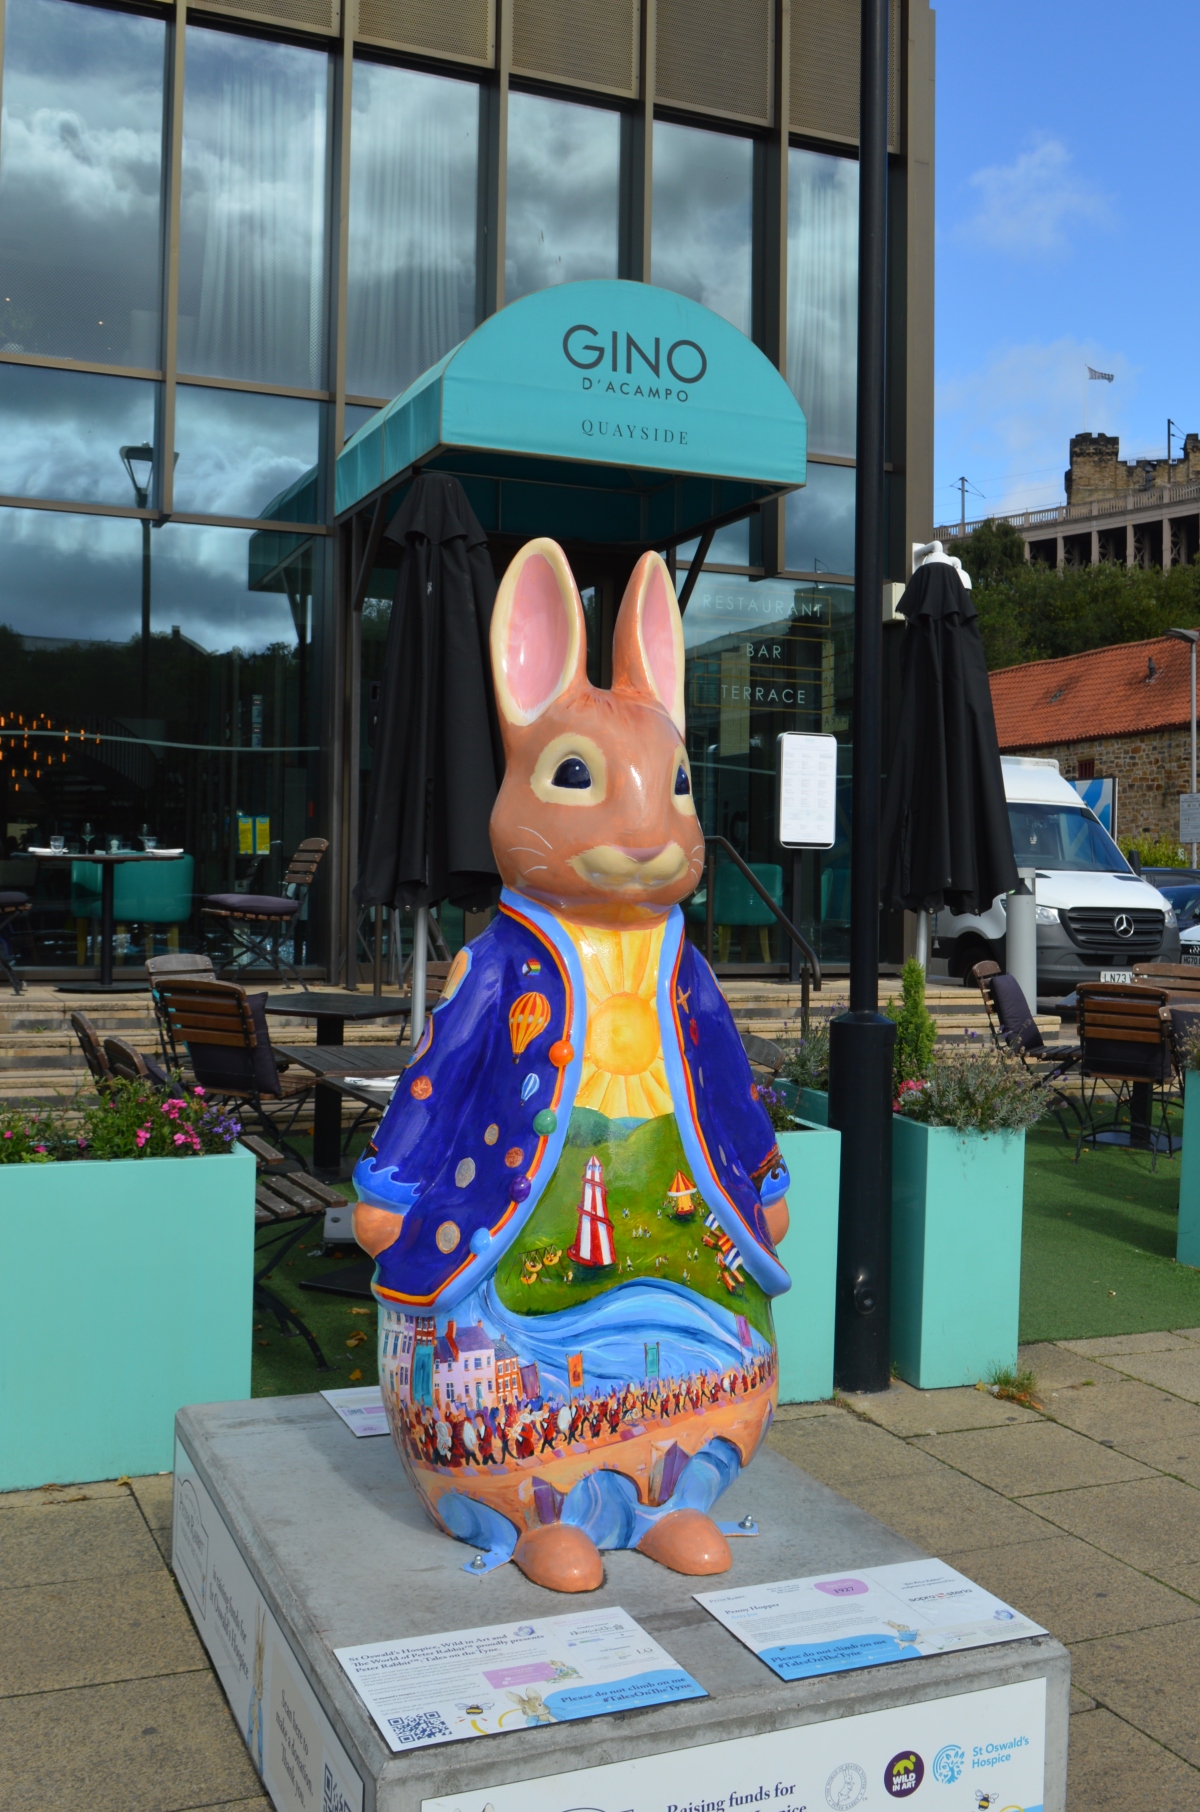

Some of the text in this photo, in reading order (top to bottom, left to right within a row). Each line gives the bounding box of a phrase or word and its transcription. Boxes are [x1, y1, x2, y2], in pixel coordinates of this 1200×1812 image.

[562, 324, 707, 384] GINO
[582, 377, 688, 402] D'ACAMPO
[581, 419, 688, 445] QUAYSIDE
[703, 594, 823, 618] RESTAURANT
[746, 643, 781, 659] BAR
[721, 685, 806, 704] TERRACE
[833, 1586, 854, 1594] 1927
[749, 1603, 779, 1611] Hopper
[360, 1651, 400, 1660] Oswald's
[401, 1646, 440, 1654] Hospice,
[370, 1656, 399, 1664] World
[476, 1640, 508, 1650] proudly
[510, 1635, 544, 1644] presents
[770, 1655, 801, 1663] Please
[833, 1643, 859, 1652] climb
[777, 1651, 865, 1669] #TalesOnTheTyne
[561, 1694, 593, 1703] Please
[628, 1682, 655, 1691] climb
[603, 1684, 692, 1703] #TalesOnTheTyne
[276, 1711, 287, 1742] make
[281, 1689, 309, 1756] Scan here to
[972, 1736, 1029, 1757] St Oswald's
[281, 1742, 295, 1786] Thank
[972, 1753, 1011, 1769] Hospice
[892, 1780, 916, 1792] IN ART
[893, 1773, 916, 1785] WILD
[728, 1785, 771, 1808] funds
[773, 1782, 796, 1799] for
